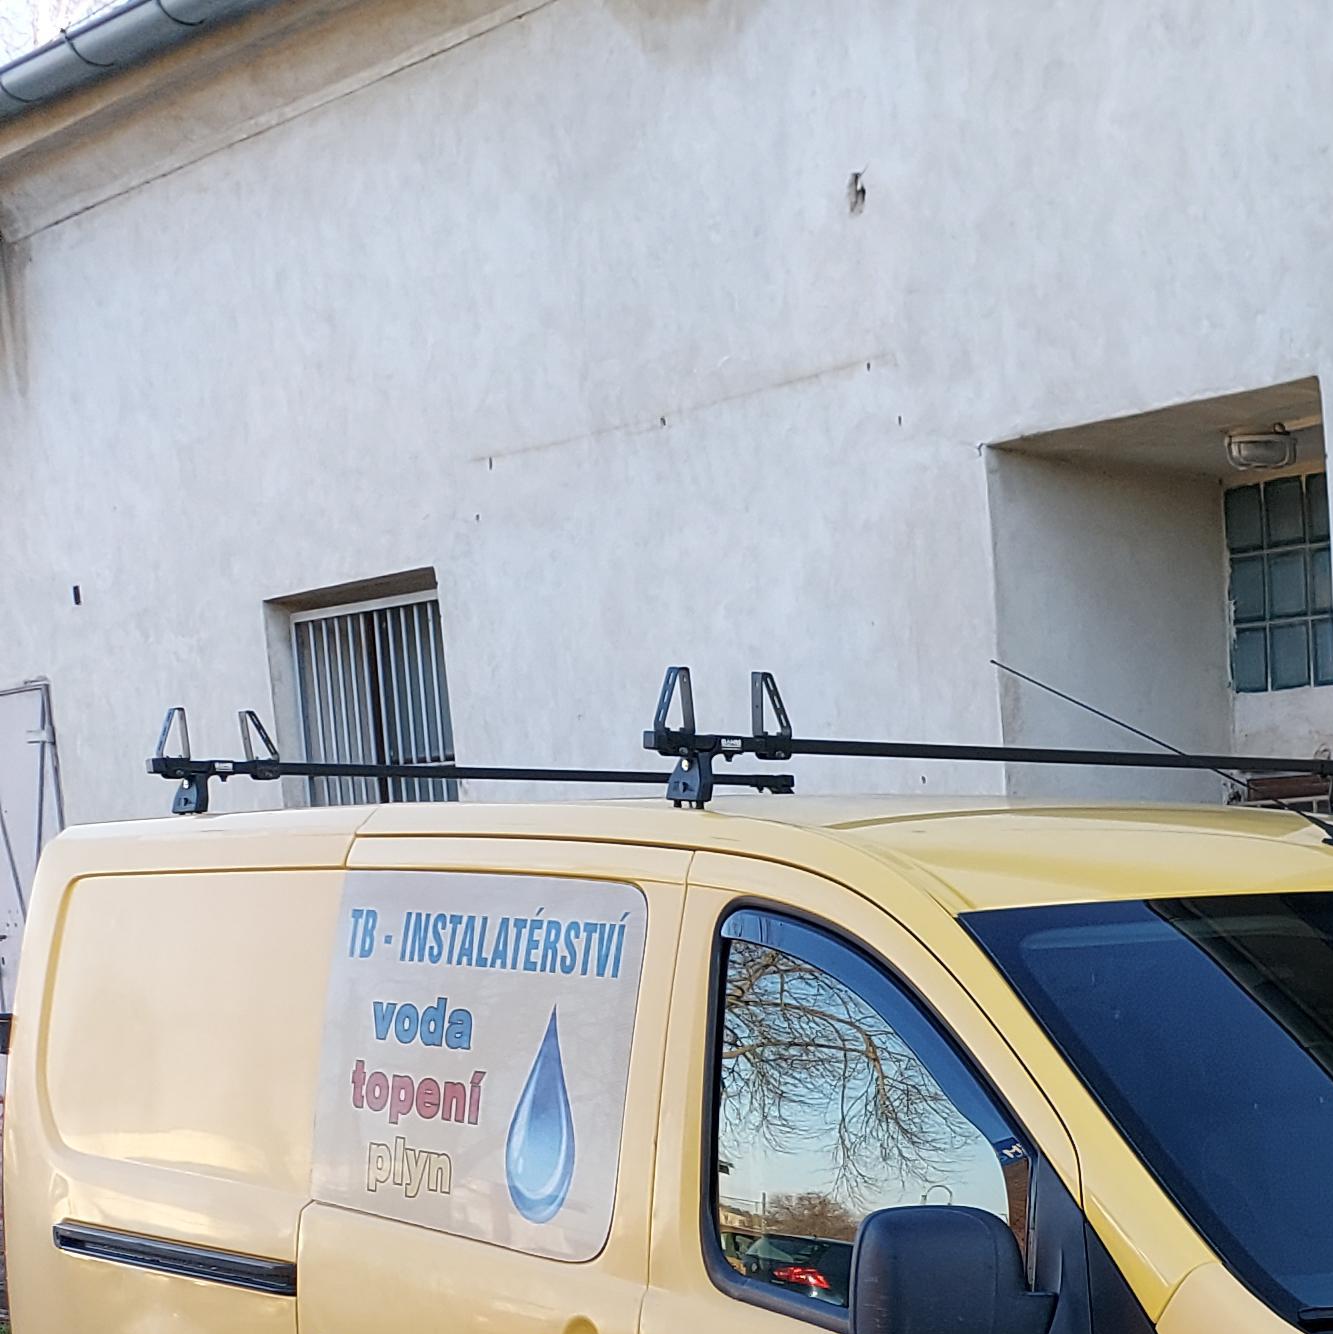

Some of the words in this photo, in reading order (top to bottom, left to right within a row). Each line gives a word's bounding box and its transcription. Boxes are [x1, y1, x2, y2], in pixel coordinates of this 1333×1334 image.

[348, 908, 379, 958] TB
[400, 907, 631, 979] INSTALATÉRSTVÍ
[373, 997, 473, 1051] voda
[351, 1059, 487, 1126] topení
[366, 1136, 452, 1199] plyn
